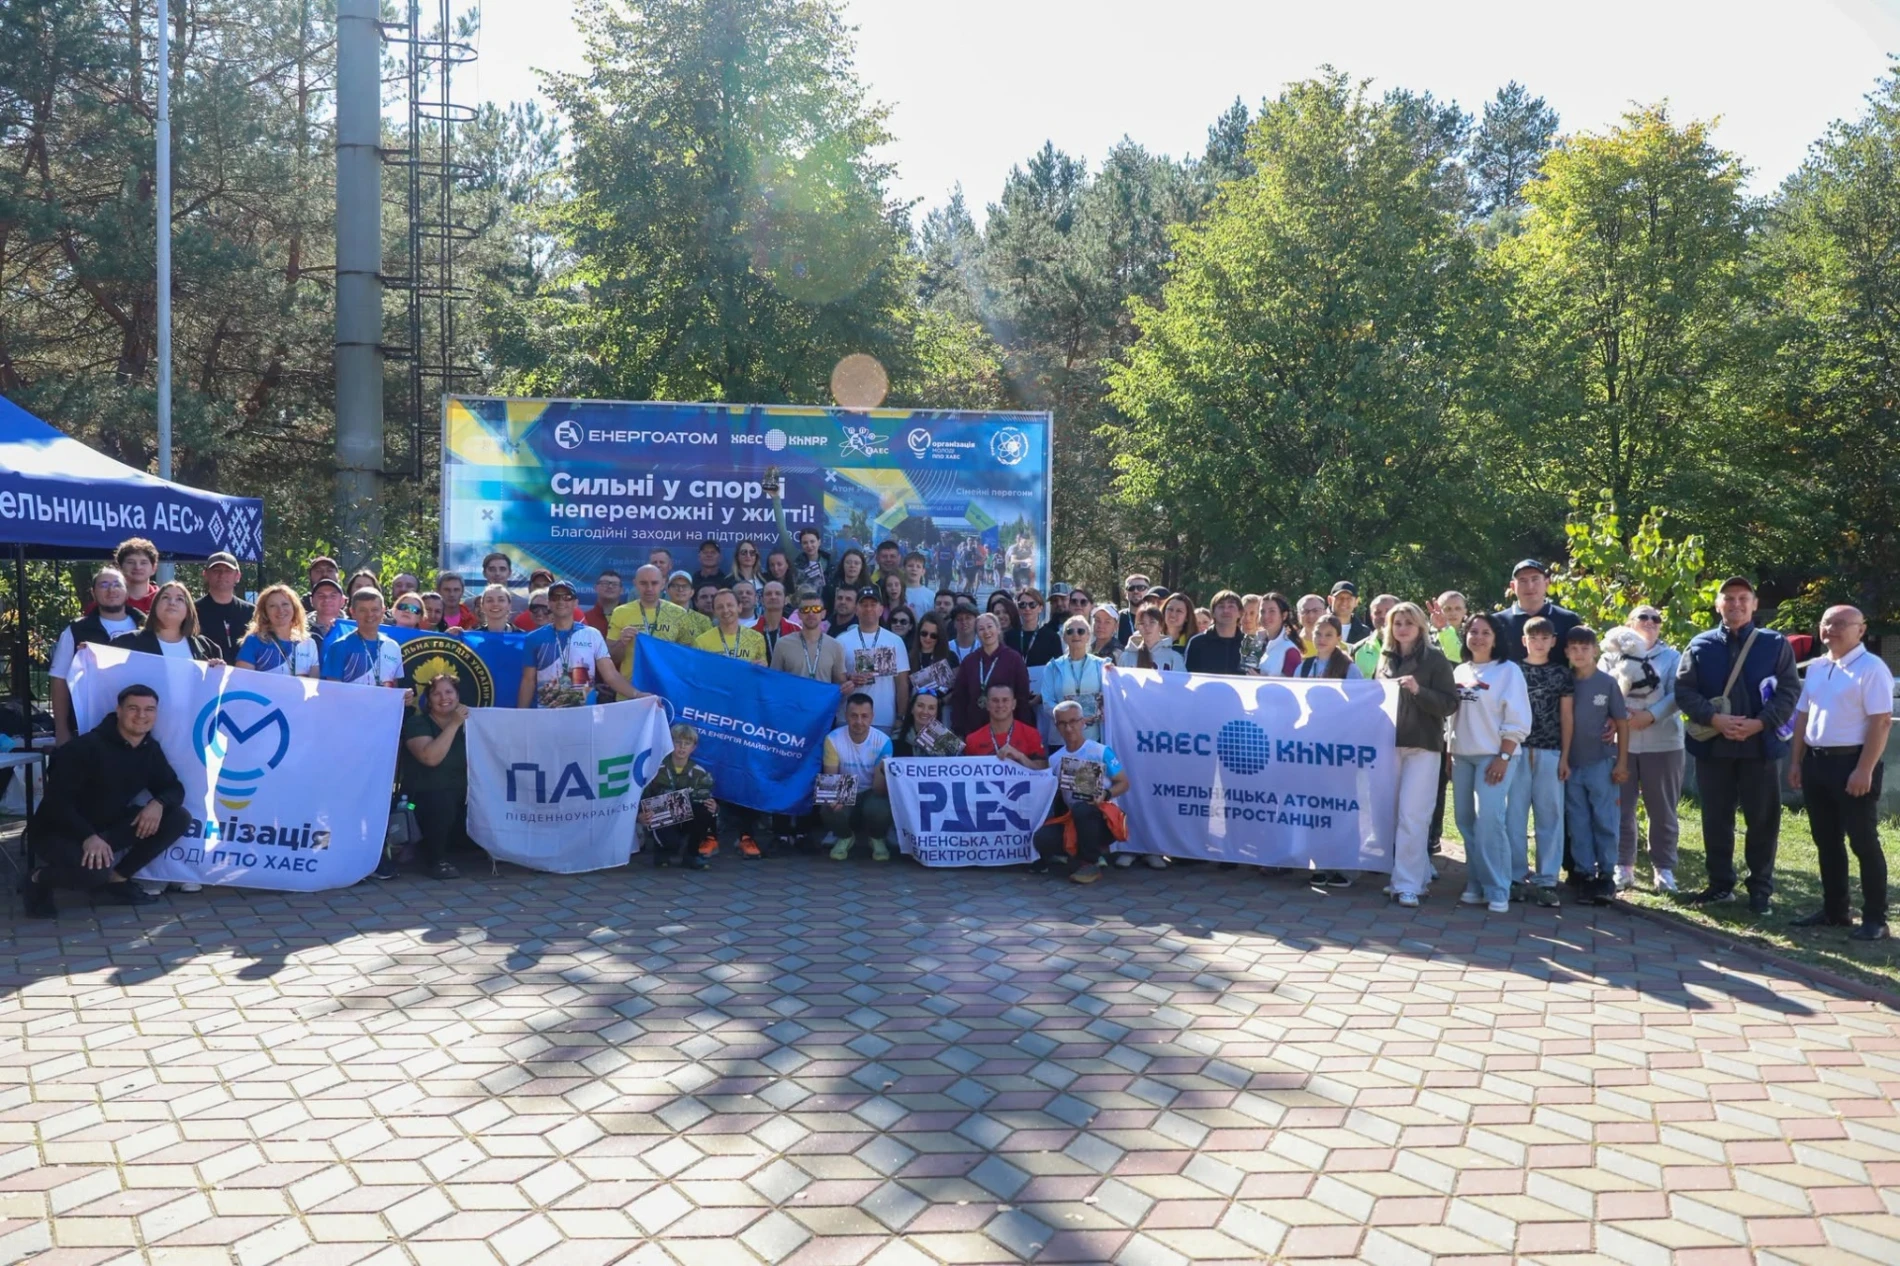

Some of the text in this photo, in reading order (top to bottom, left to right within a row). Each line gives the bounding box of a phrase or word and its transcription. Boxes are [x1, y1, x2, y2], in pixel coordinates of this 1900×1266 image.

[588, 430, 718, 445] ЕНЕРГОАТОМ
[932, 441, 975, 449] організація
[551, 472, 785, 503] Сильні у спорі
[956, 487, 1033, 499] Сімейні перегони
[153, 501, 204, 534] АЕС»
[550, 503, 714, 523] непереможні
[721, 507, 735, 525] у
[550, 526, 628, 541] Благодійні
[631, 530, 681, 541] заходи
[686, 531, 703, 541] на
[706, 528, 780, 544] підтримку
[433, 641, 471, 660] ГВАРДІЯ
[471, 659, 490, 699] УКРАЇНИ
[682, 706, 806, 749] ЕНЕРГОАТОМ
[708, 730, 742, 744] ЕНЕРГІЯ
[743, 739, 803, 759] МАЙБУТНЬОГО
[1136, 730, 1211, 757] ХАЕС
[906, 763, 1017, 778] ENERGOATOM
[1151, 783, 1360, 812] ХМЕЛЬНИЦЬКА АТОМНА
[1178, 803, 1332, 829] ЕЛЕКТРОСТАНЦІЯ
[184, 816, 331, 851] анізація
[212, 850, 258, 867] ППО
[263, 855, 319, 873] ХАЕС
